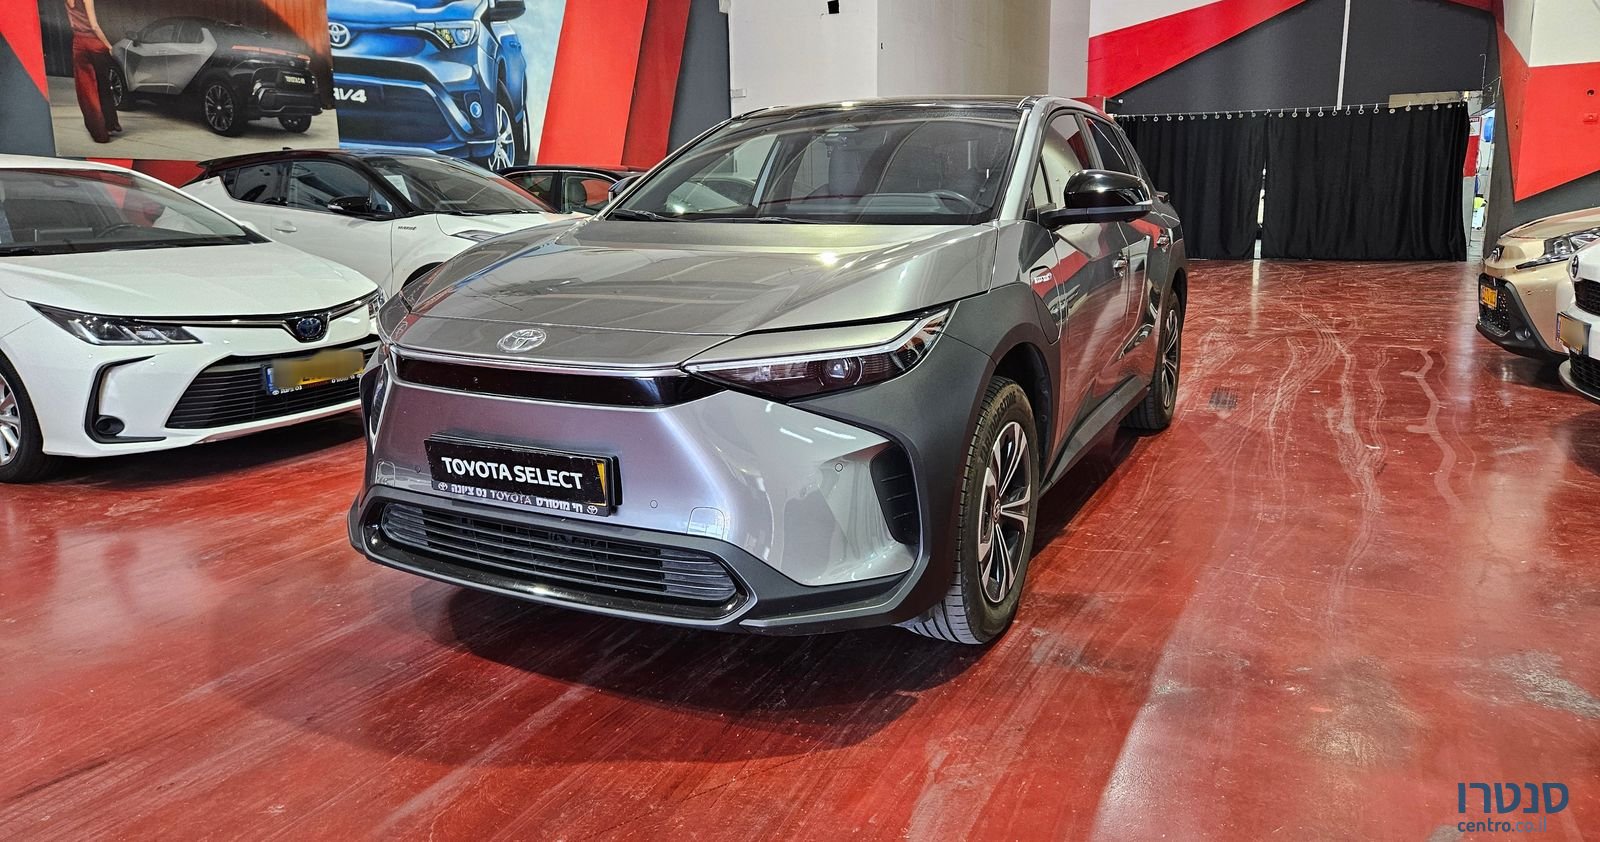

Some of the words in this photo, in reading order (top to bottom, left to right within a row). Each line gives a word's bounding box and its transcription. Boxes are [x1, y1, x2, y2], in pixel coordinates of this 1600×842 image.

[441, 456, 513, 482] TOYOTA
[514, 467, 583, 490] SELECT
[475, 487, 487, 498] נס
[490, 489, 532, 505] TOYOTA
